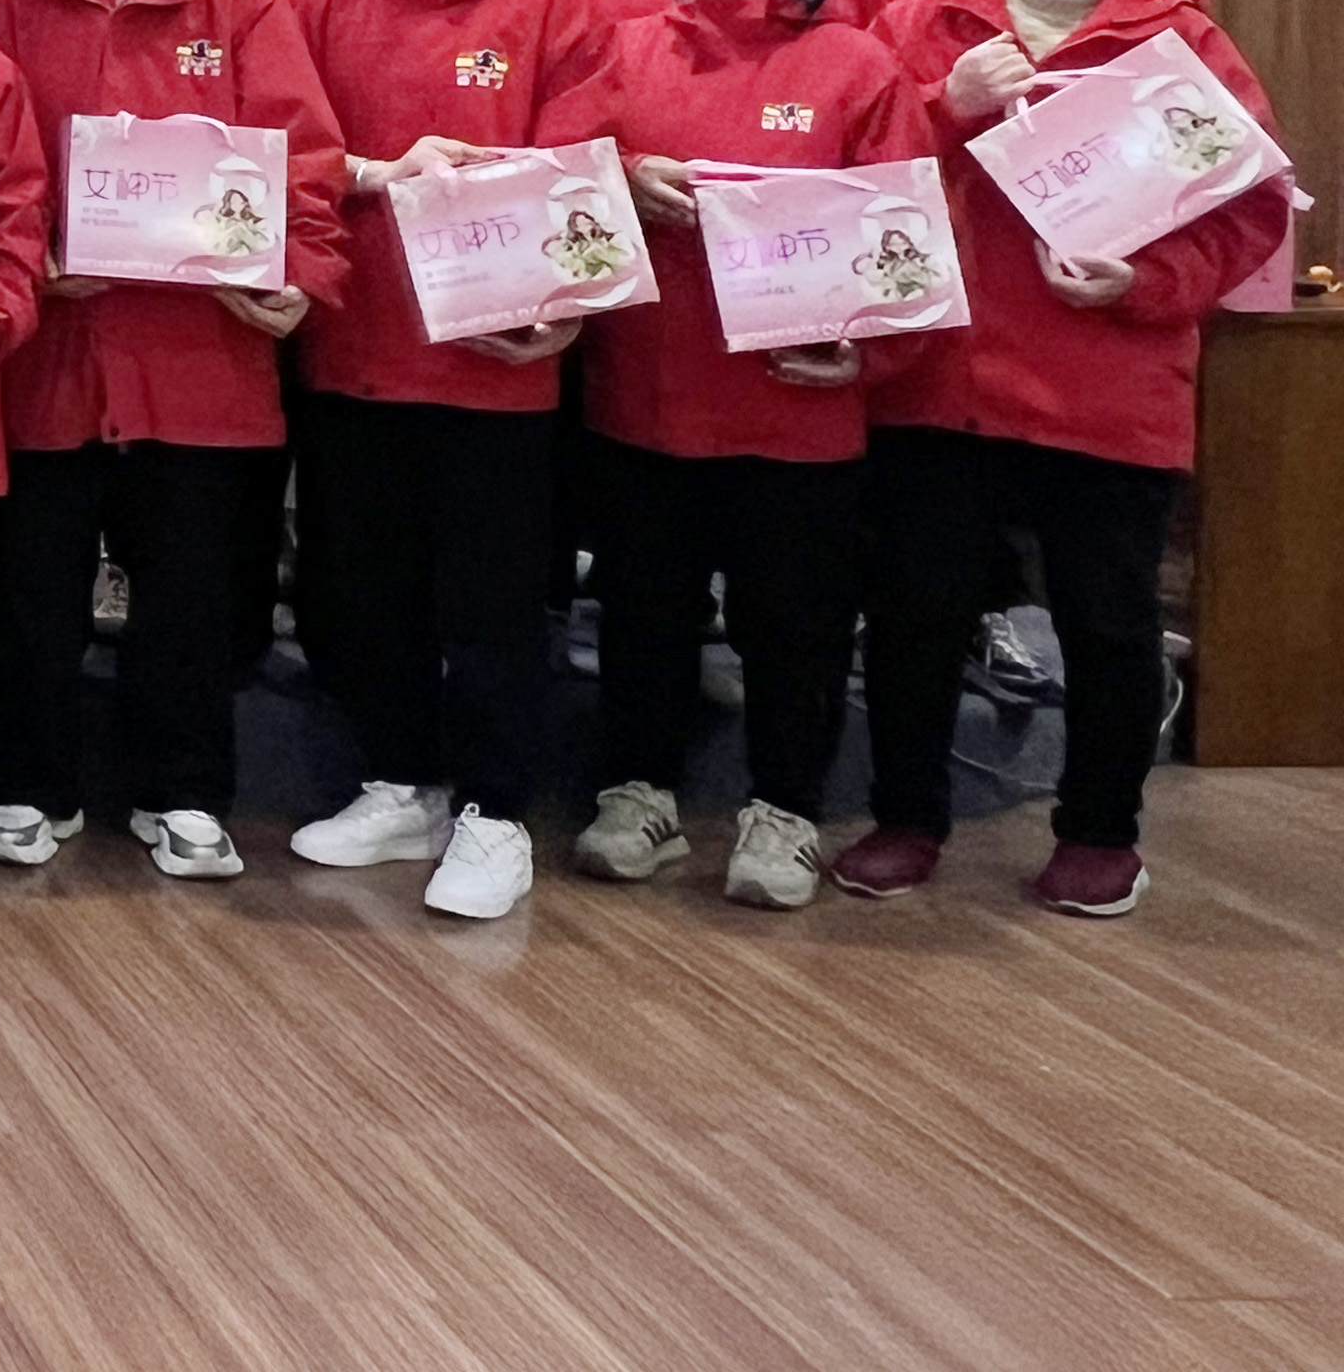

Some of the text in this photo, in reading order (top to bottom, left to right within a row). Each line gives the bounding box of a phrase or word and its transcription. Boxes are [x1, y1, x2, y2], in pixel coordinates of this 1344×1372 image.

[82, 168, 180, 202] 女神节
[417, 213, 522, 264] 女神节
